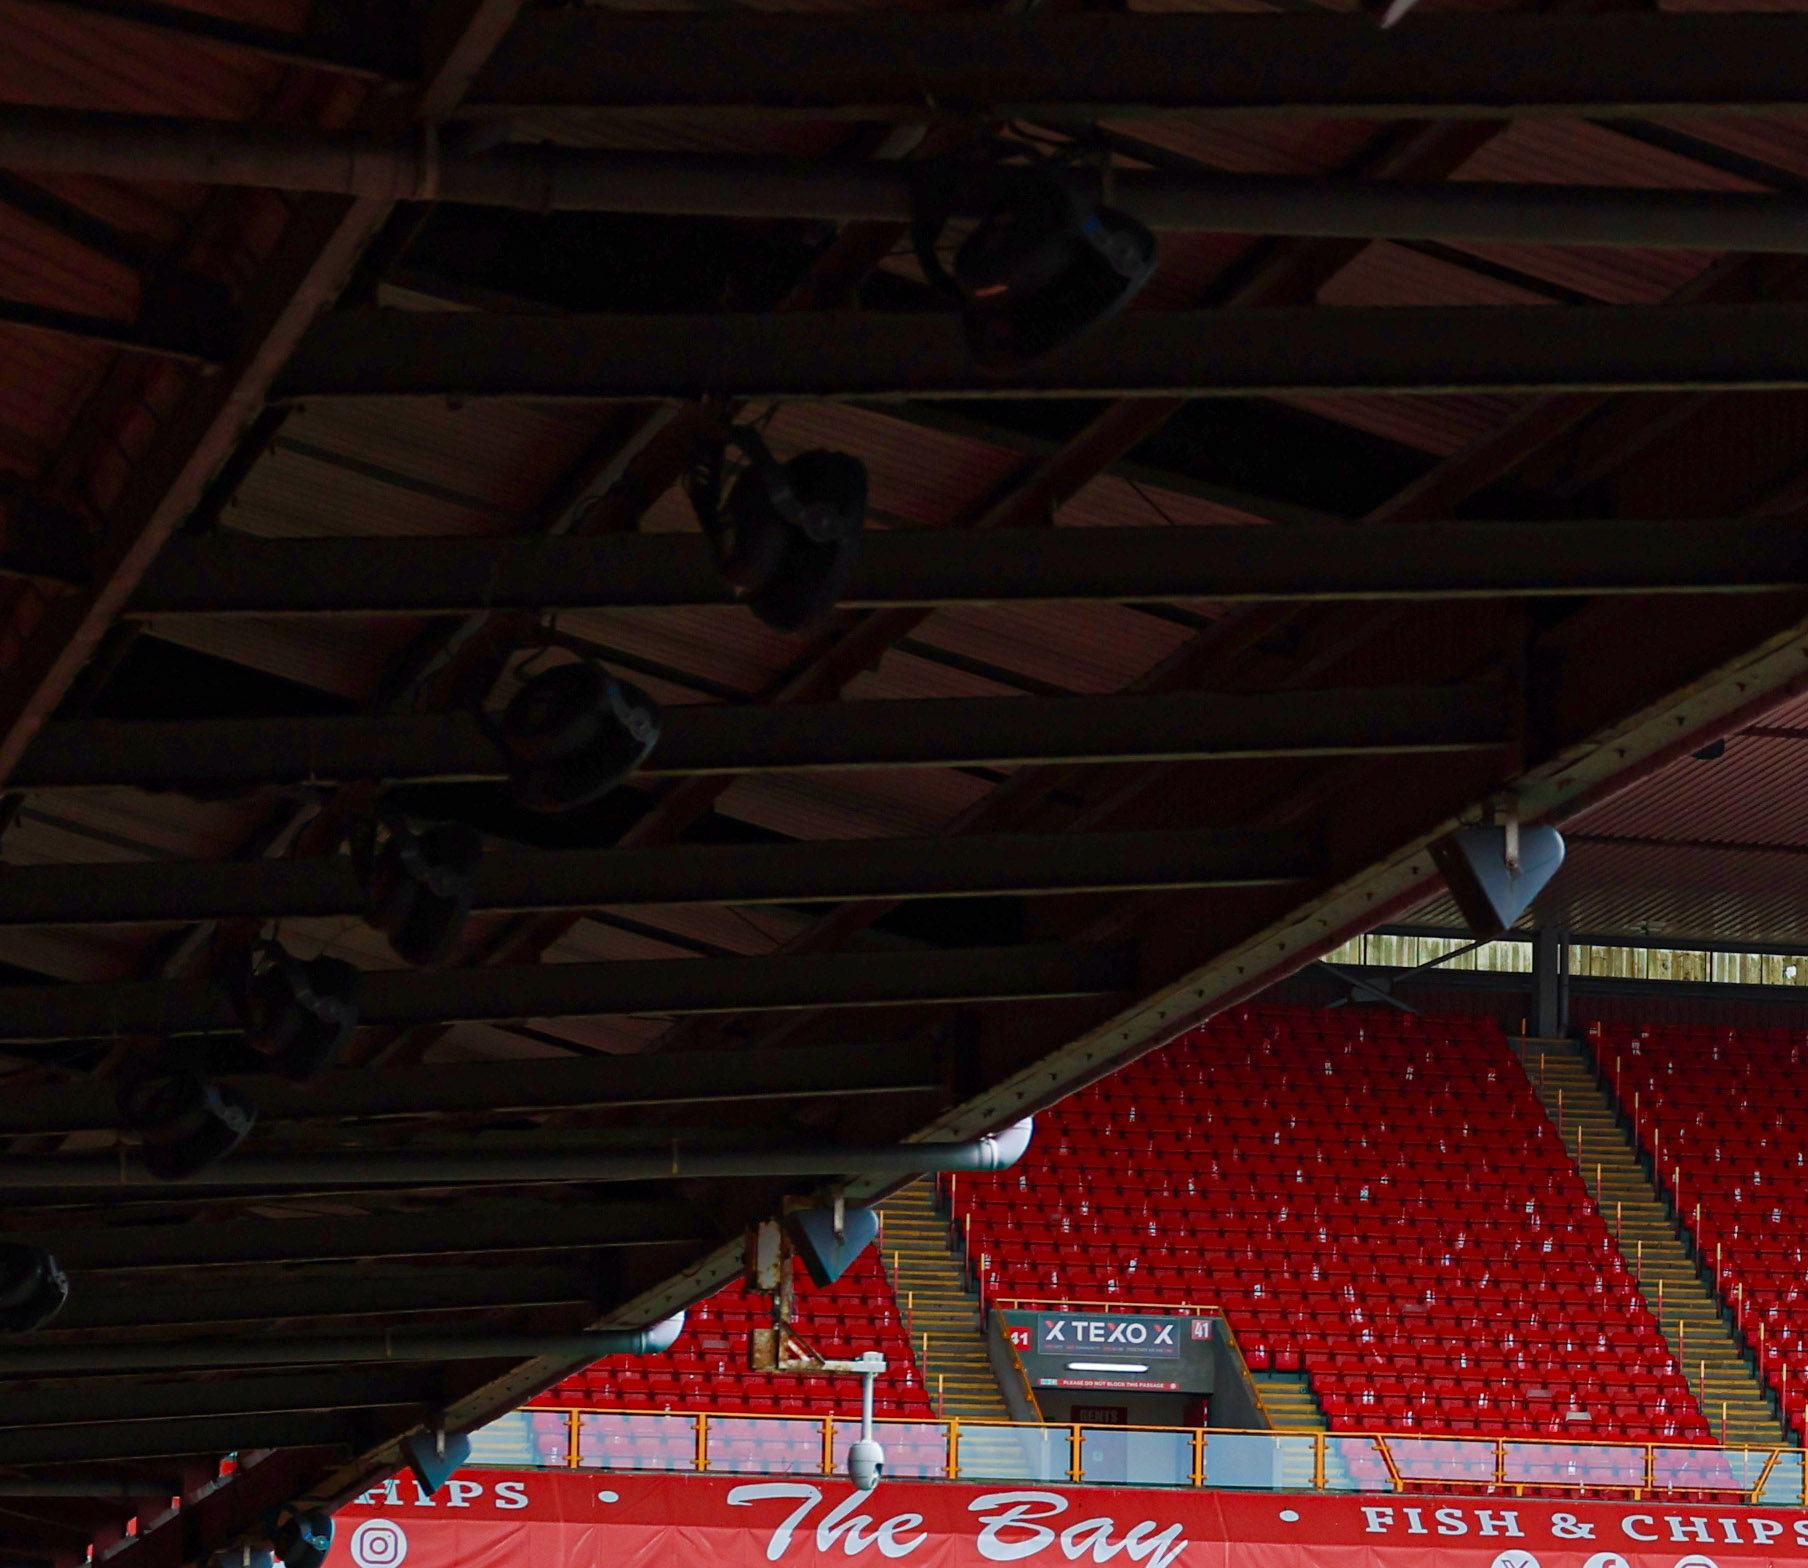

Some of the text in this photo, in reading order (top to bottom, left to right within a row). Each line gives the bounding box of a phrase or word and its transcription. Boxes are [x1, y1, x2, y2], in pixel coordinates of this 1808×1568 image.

[1071, 1321, 1147, 1344] TEXO
[1194, 1321, 1209, 1338] 41
[354, 1479, 529, 1509] HIPS
[727, 1483, 927, 1562] The
[1361, 1506, 1526, 1537] FISH
[1551, 1512, 1595, 1540] &
